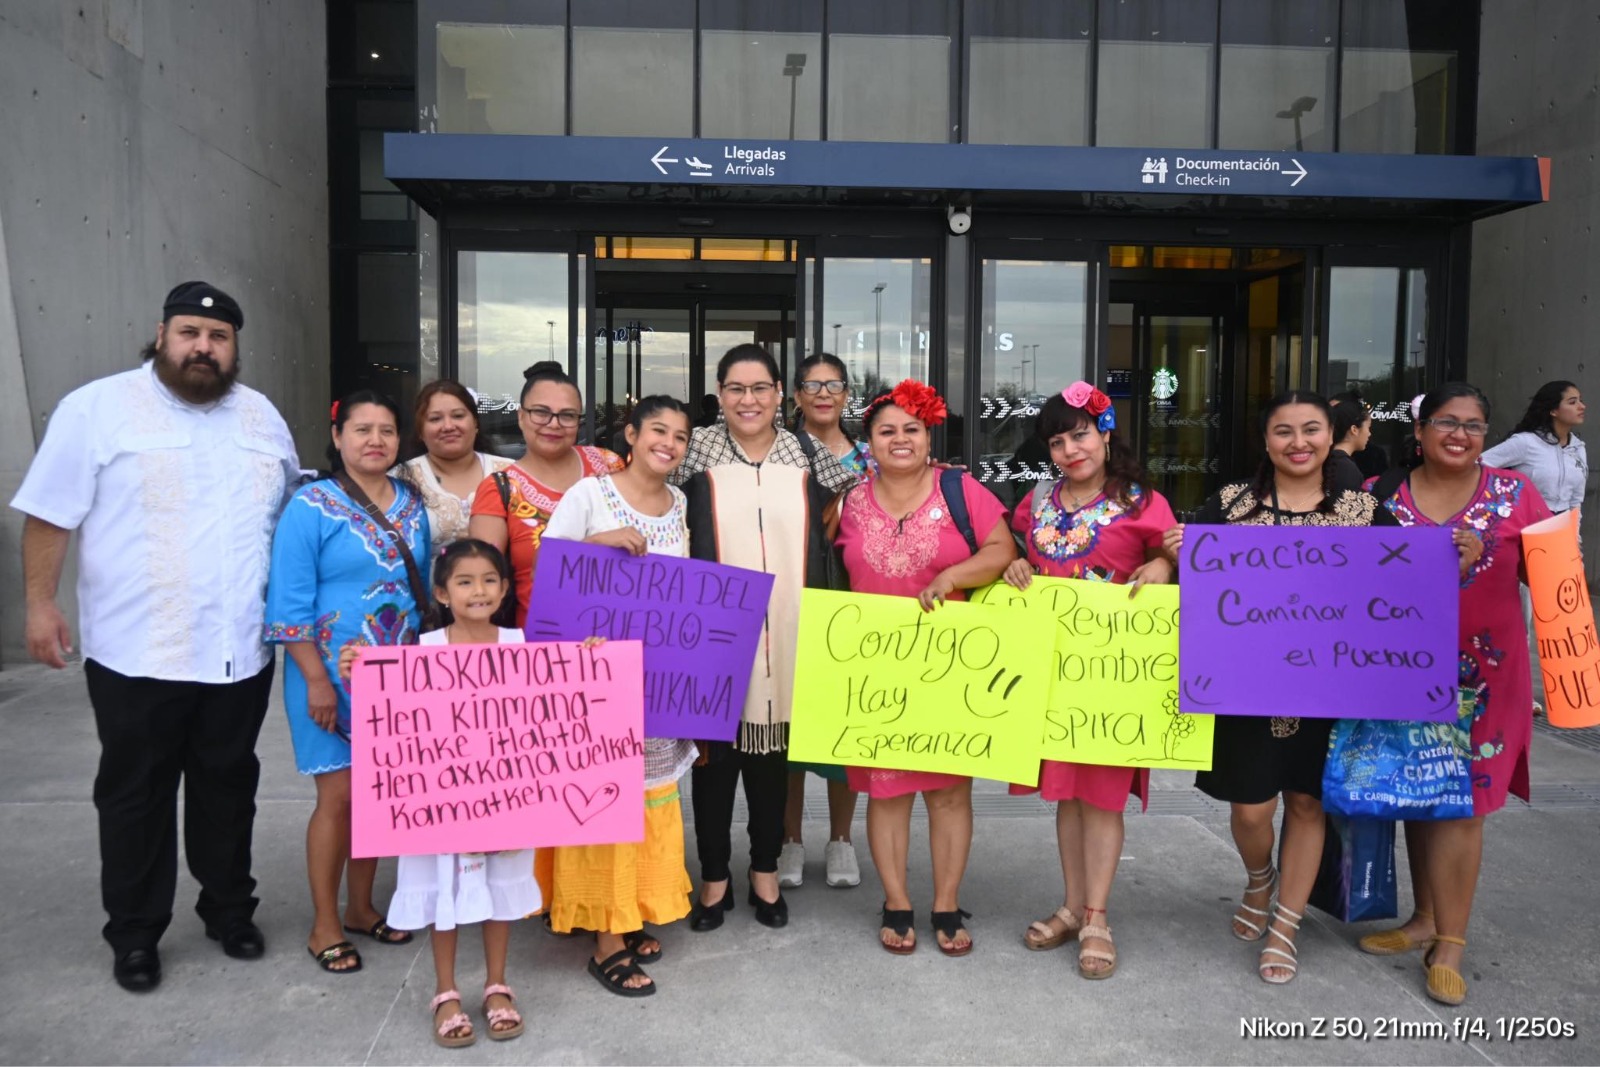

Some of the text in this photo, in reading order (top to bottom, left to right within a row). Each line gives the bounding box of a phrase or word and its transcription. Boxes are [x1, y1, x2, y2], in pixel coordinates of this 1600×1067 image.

[725, 145, 786, 162] Llegadas
[725, 162, 775, 176] Arrivals
[1176, 157, 1280, 171] Documentación
[1176, 173, 1230, 186] Check-in
[1371, 410, 1399, 419] OMA
[1025, 470, 1054, 480] OMA
[1190, 532, 1349, 573] Gracias
[558, 554, 755, 612] MINISTRA DEL
[1217, 588, 1347, 626] Caminar
[1283, 648, 1316, 667] el
[644, 671, 733, 722] HIKAWA
[846, 675, 908, 725] Hay
[366, 698, 431, 738] tlen
[1043, 707, 1146, 750] spira
[831, 725, 993, 761] Esperanza
[371, 770, 428, 801] tlen
[1350, 791, 1361, 801] EL
